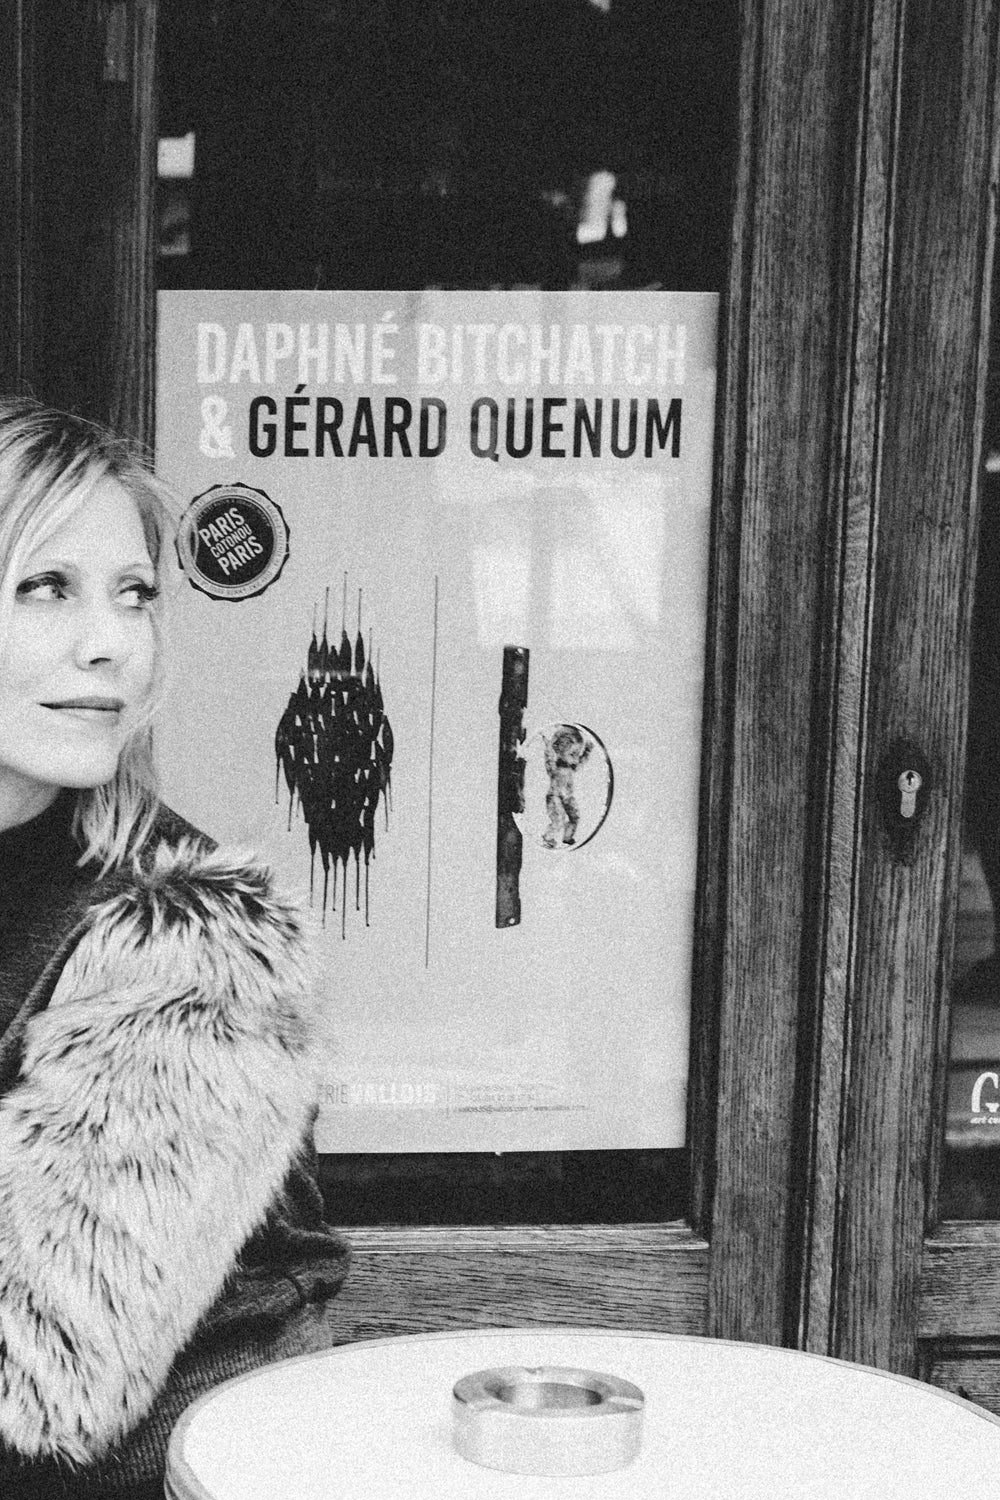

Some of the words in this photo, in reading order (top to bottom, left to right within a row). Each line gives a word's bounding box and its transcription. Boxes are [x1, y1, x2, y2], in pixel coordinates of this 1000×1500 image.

[197, 311, 399, 384] DAPHNÉ
[417, 321, 687, 385] BITCHATCH
[200, 395, 236, 458] &
[248, 383, 448, 459] GÉRARD
[469, 396, 684, 462] QUENUM
[198, 506, 246, 548] PARIS
[209, 523, 253, 559] COTONOU
[217, 535, 264, 577] PARIS
